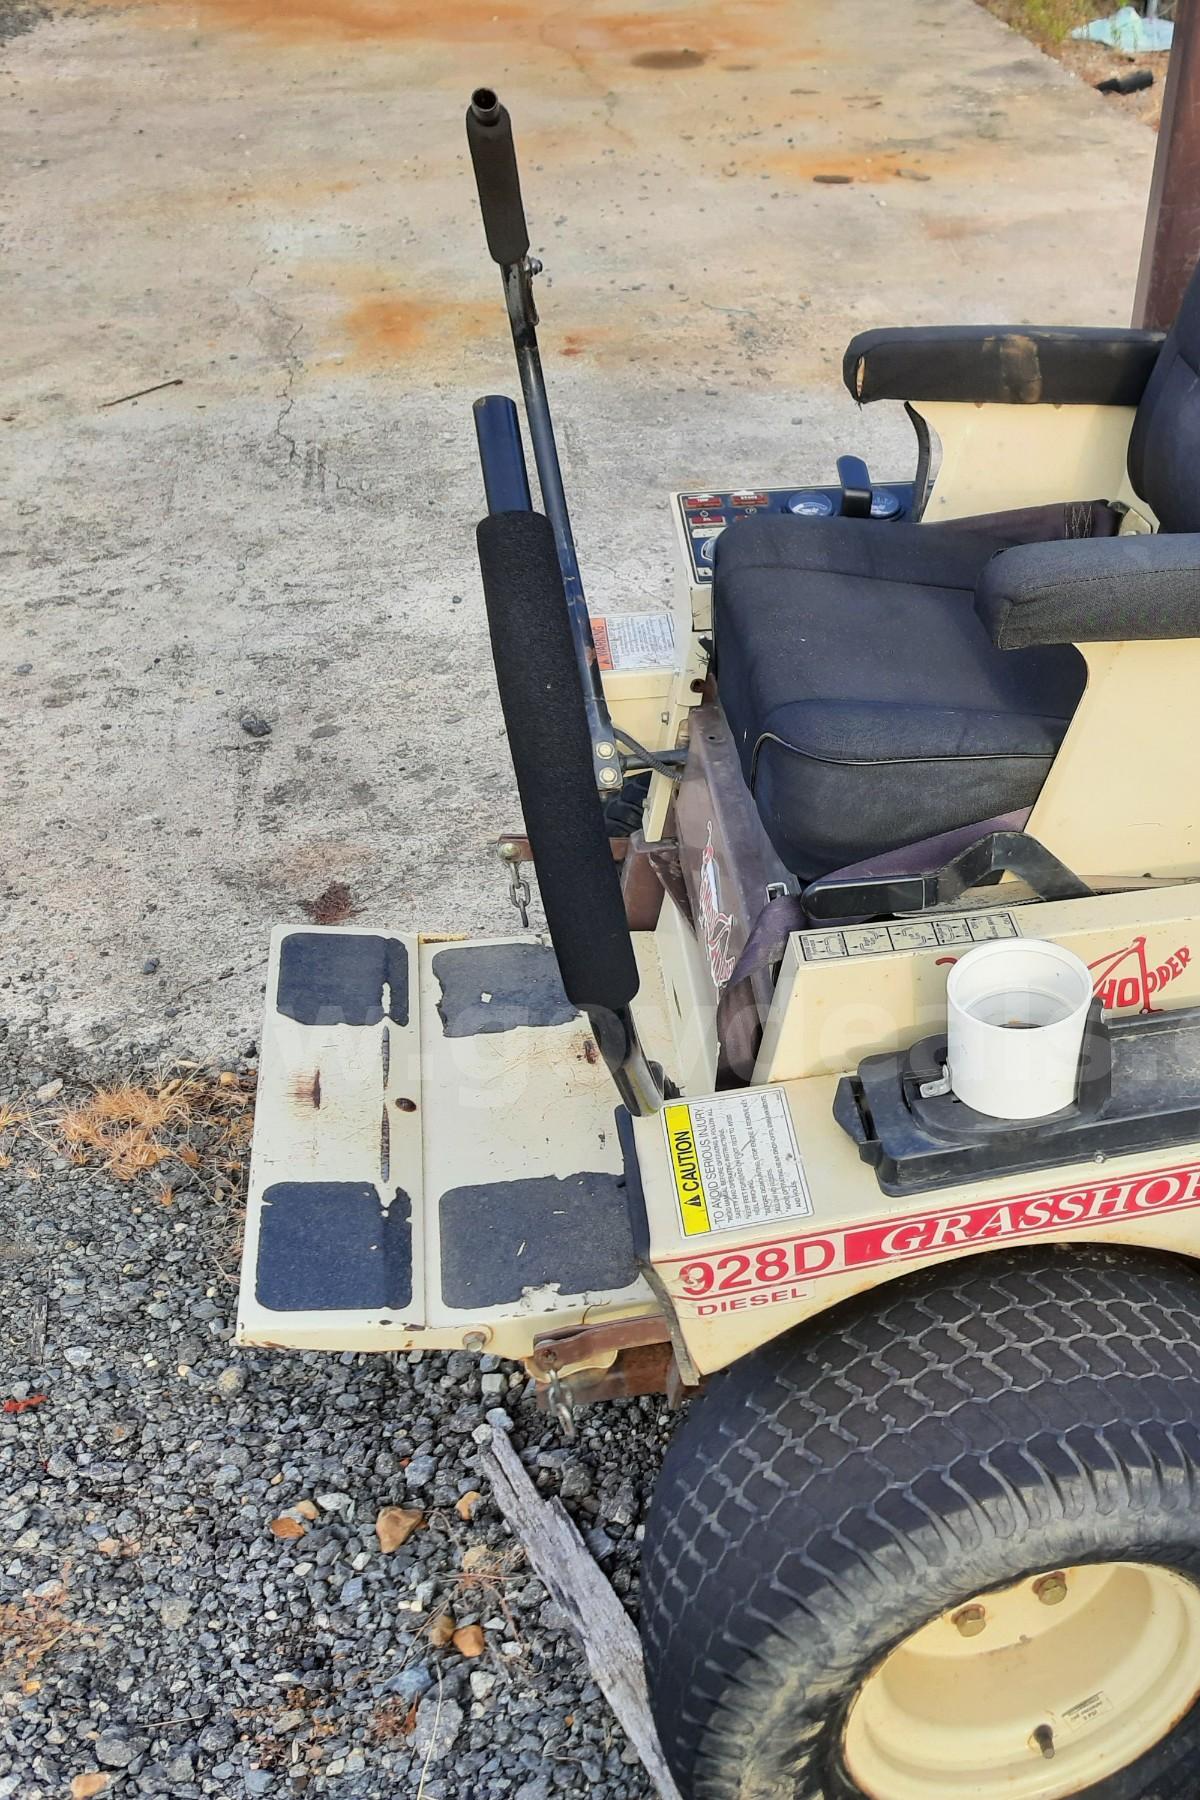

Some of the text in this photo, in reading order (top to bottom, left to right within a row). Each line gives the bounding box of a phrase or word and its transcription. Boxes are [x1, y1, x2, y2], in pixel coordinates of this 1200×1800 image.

[593, 625, 609, 657] WARNING
[673, 1130, 700, 1192] CAUTION
[699, 1138, 716, 1179] SERIOUS
[707, 1180, 722, 1209] AVOID
[713, 1210, 725, 1224] TO
[679, 1238, 836, 1296] 928D
[696, 1288, 808, 1316] DIESEL
